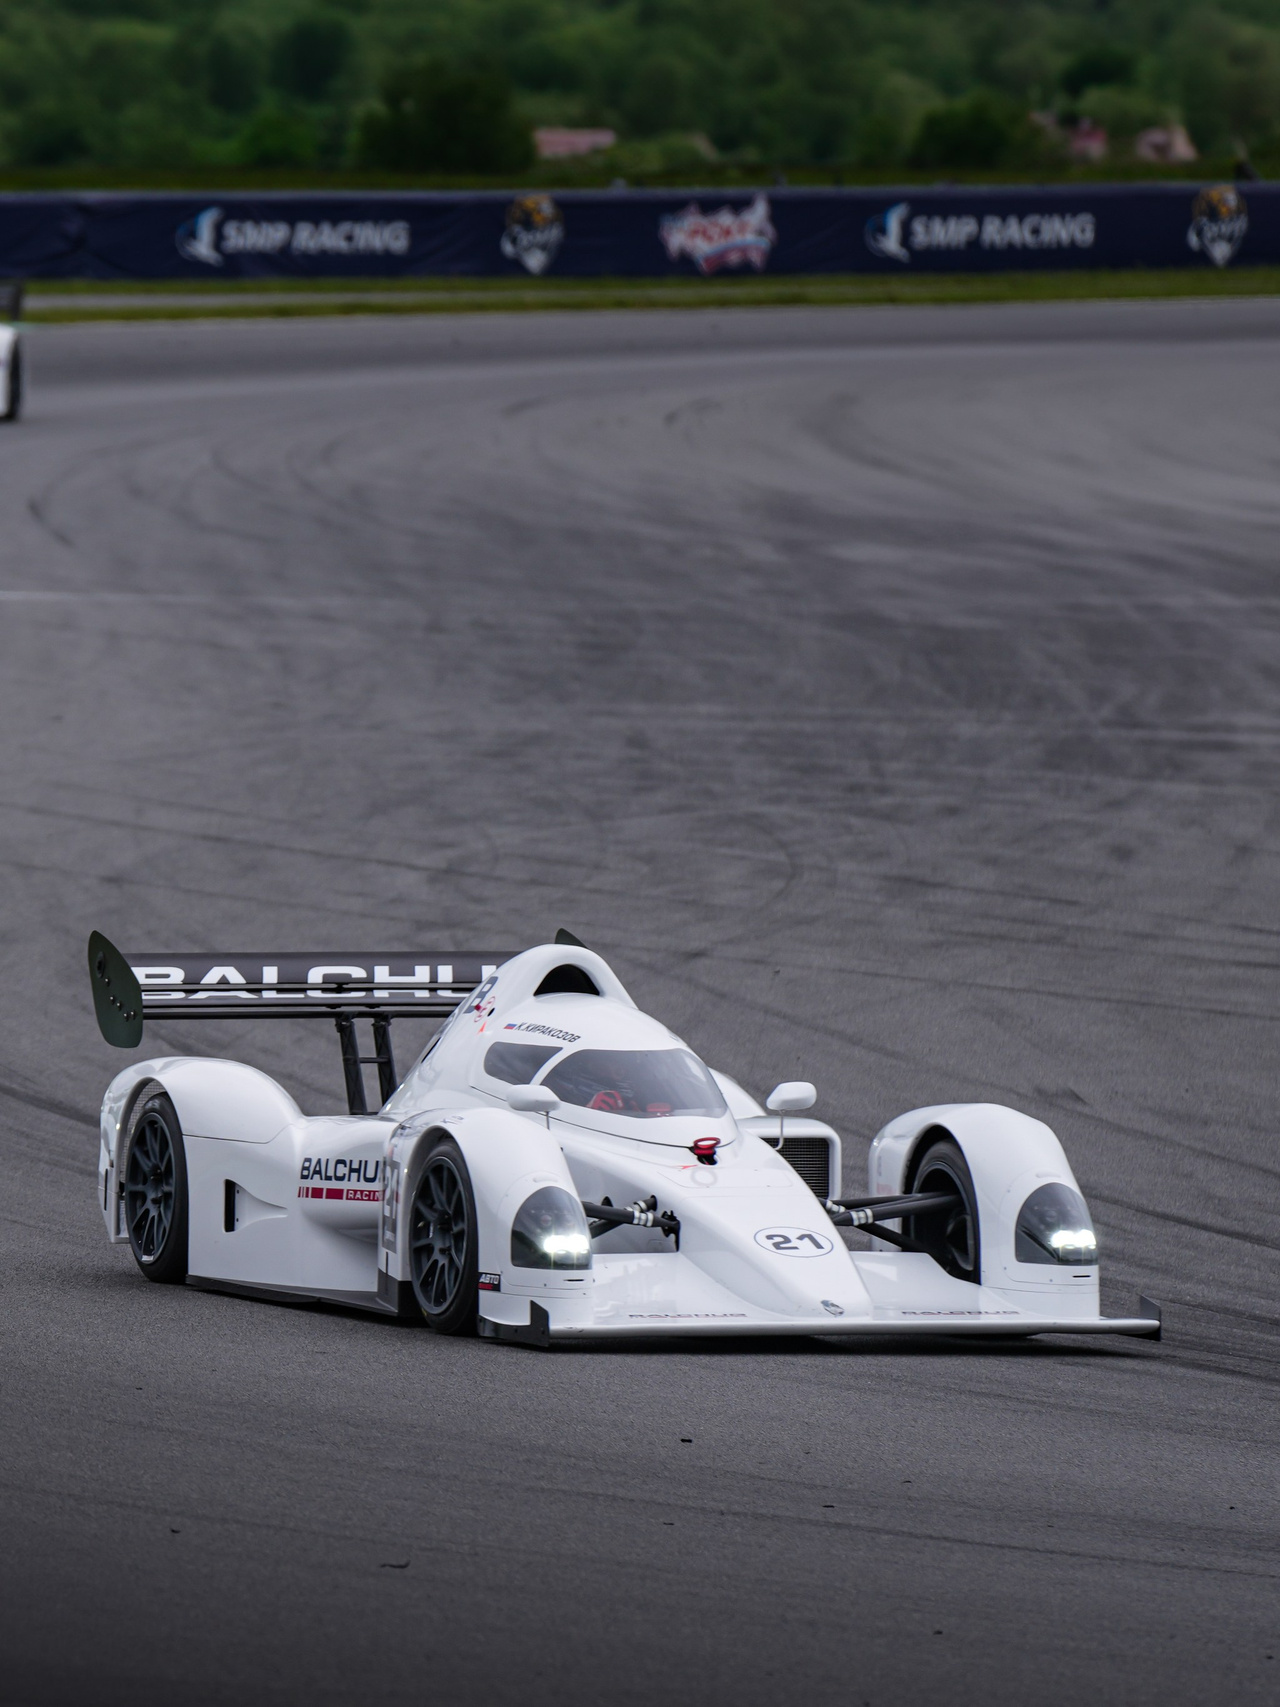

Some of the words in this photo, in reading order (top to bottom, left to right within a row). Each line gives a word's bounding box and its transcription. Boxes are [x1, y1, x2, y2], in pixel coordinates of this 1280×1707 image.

[221, 220, 290, 253] SMP
[292, 221, 410, 255] RACING
[910, 214, 978, 249] SMP
[980, 213, 1095, 248] RACING
[300, 1158, 383, 1183] BALCHU
[765, 1233, 826, 1251] 21
